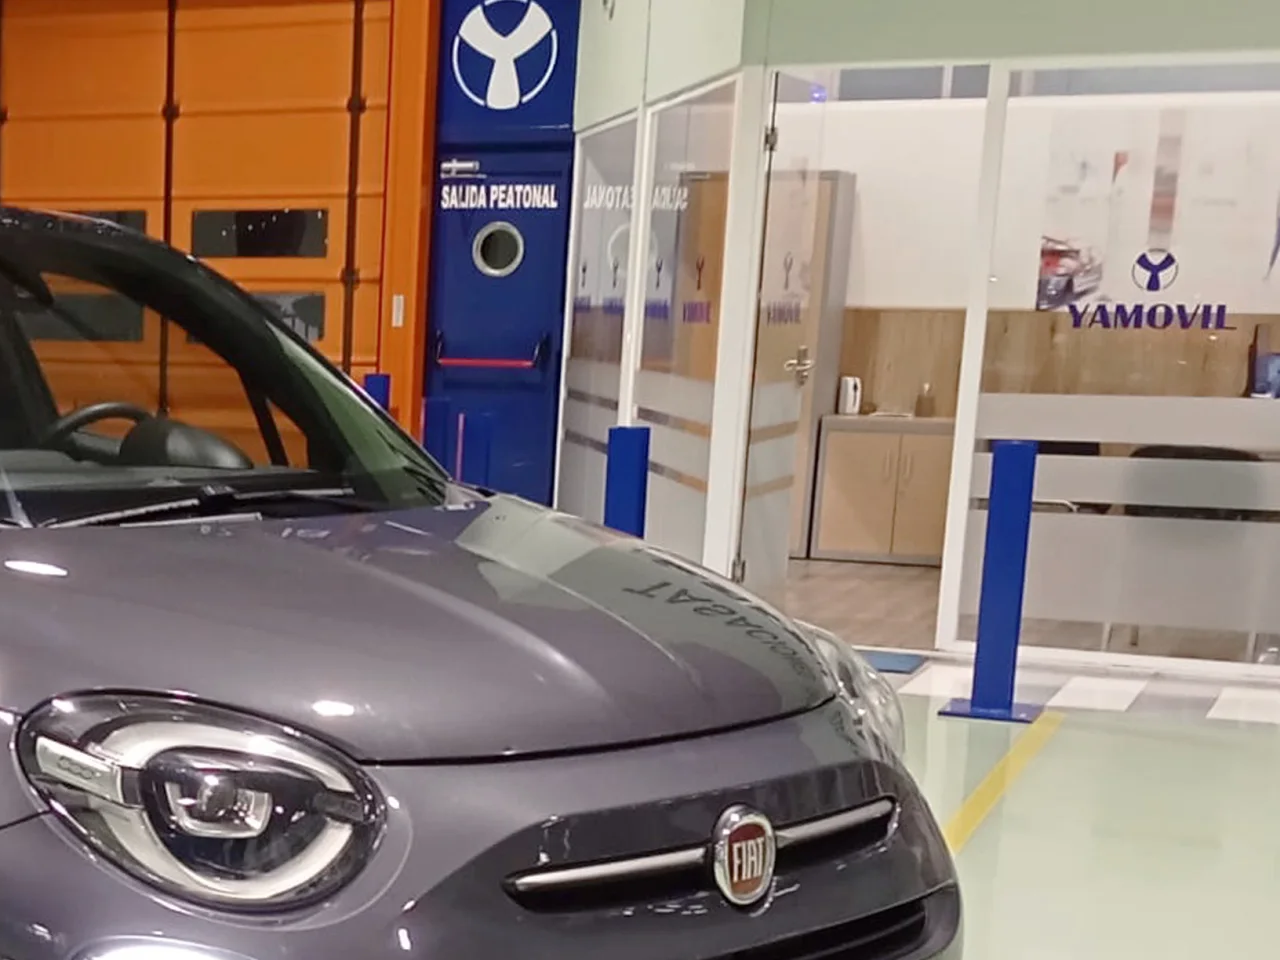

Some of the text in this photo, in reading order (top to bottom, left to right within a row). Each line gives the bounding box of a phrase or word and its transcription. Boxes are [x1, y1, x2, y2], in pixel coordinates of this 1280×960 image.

[441, 184, 558, 209] SALIDA PEATONAL
[1067, 303, 1237, 330] YAMOVIL
[731, 836, 767, 884] FIAT
